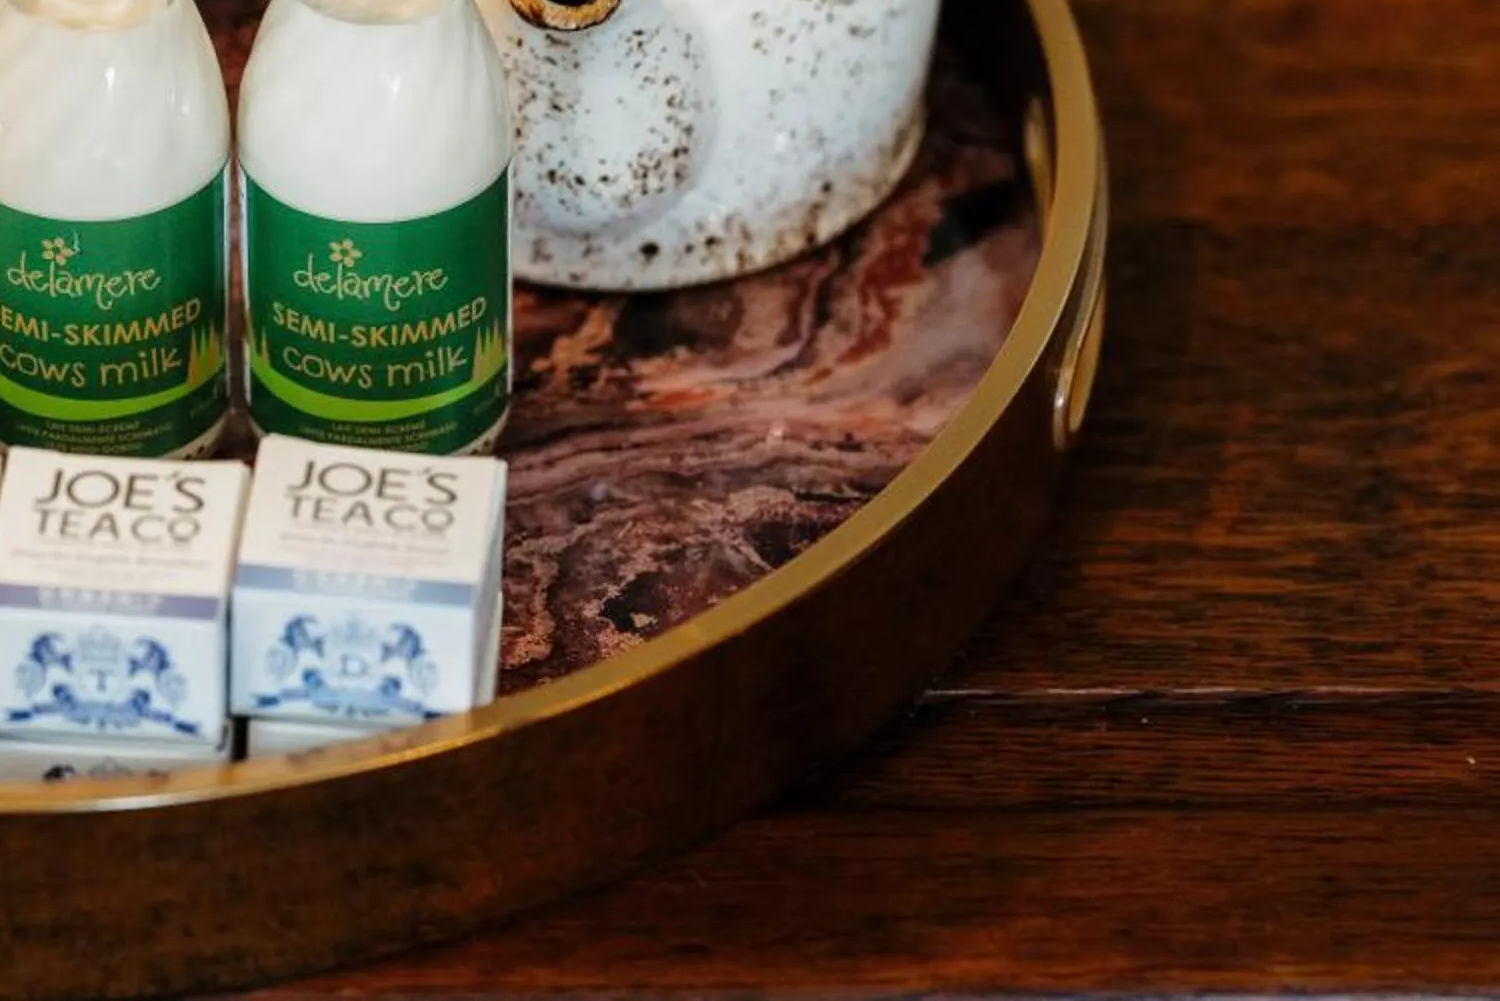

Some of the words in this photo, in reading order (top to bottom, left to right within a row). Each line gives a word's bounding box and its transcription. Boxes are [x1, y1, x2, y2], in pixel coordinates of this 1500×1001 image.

[7, 251, 161, 310] delamere
[293, 253, 448, 311] delamere
[272, 297, 487, 347] SEMI-SKIMMED
[99, 347, 182, 386] milk
[387, 346, 468, 387] milk
[34, 467, 205, 514] JOE'S
[287, 459, 459, 507] JOE'S
